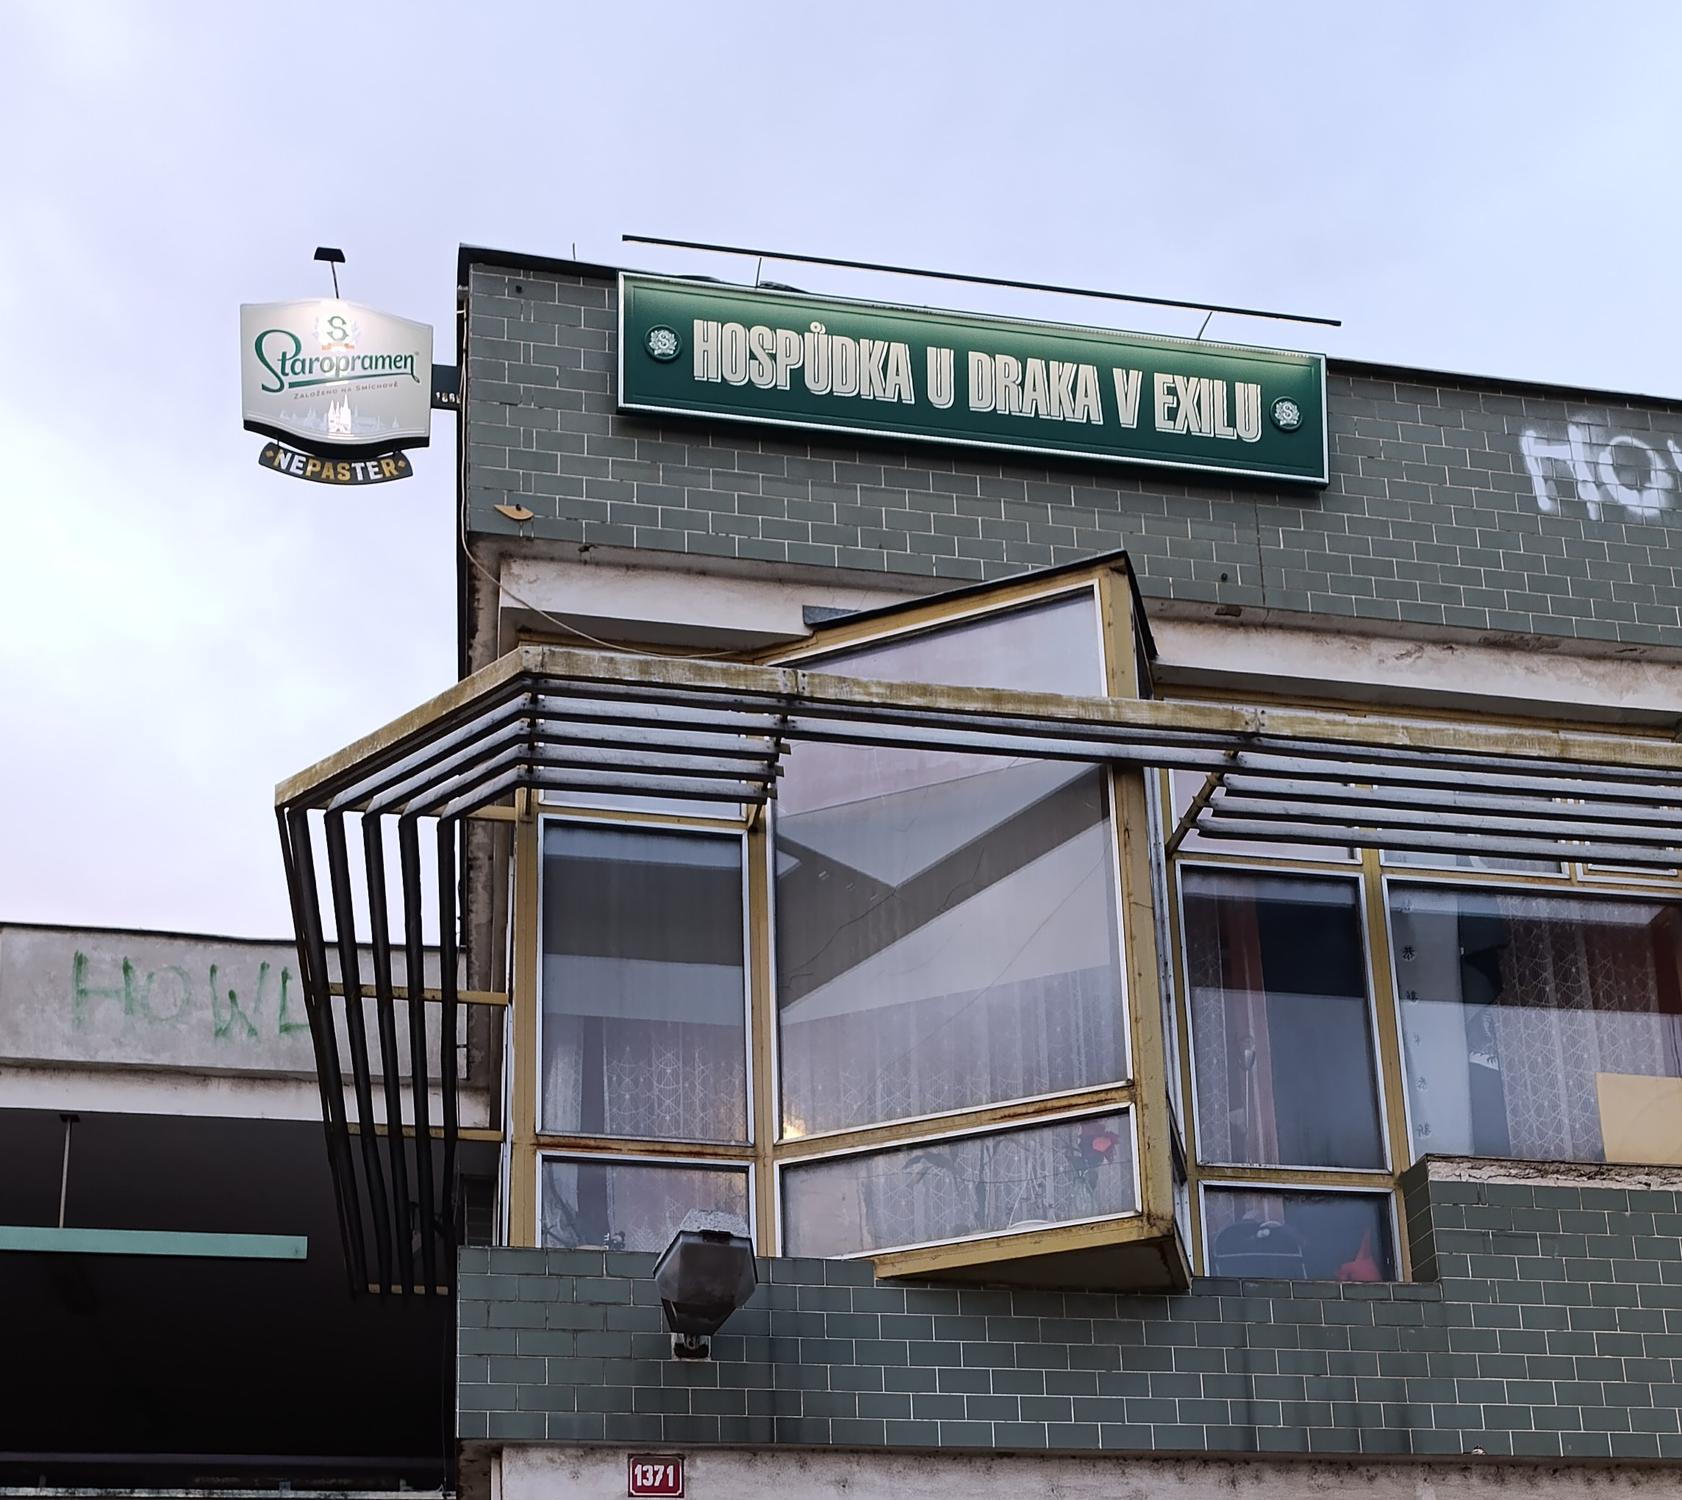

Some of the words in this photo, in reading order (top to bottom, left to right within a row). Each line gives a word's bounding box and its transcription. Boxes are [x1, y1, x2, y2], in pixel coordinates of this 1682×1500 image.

[254, 329, 420, 393] Staropramen
[693, 319, 915, 404] HOSPŮDKA
[926, 346, 955, 409] U
[968, 351, 1104, 425] DRAKA
[1112, 367, 1143, 429] V
[1153, 372, 1262, 443] EXILU
[273, 448, 399, 481] NEPASTER
[1520, 422, 1682, 522] HO
[634, 1464, 674, 1487] 1371
